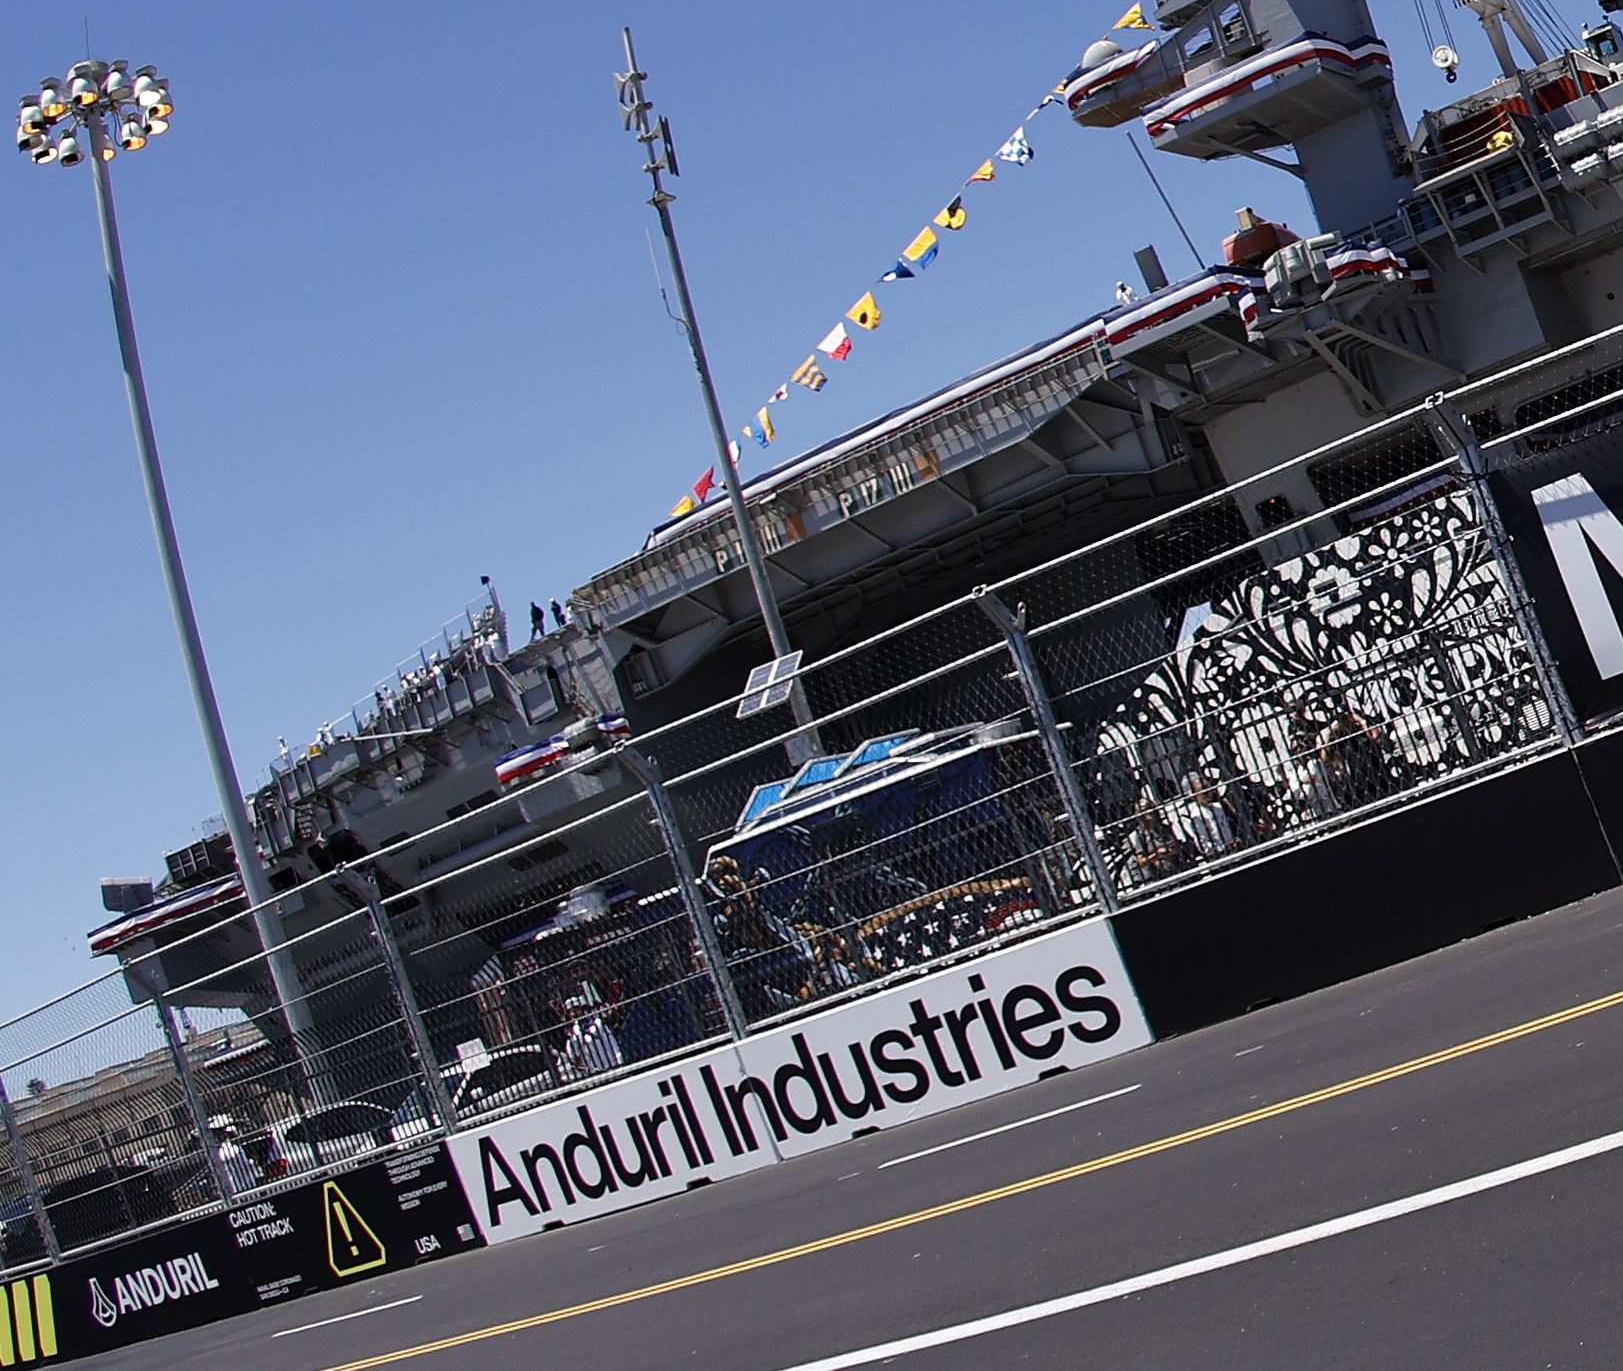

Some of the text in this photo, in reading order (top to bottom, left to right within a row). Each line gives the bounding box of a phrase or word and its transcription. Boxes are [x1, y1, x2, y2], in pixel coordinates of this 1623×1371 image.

[478, 964, 1122, 1226] Anduril Industries
[229, 1201, 277, 1229] CAUTION:
[237, 1216, 295, 1248] HOT TRACK
[414, 1234, 442, 1255] USA
[114, 1252, 220, 1315] ANDURIL
